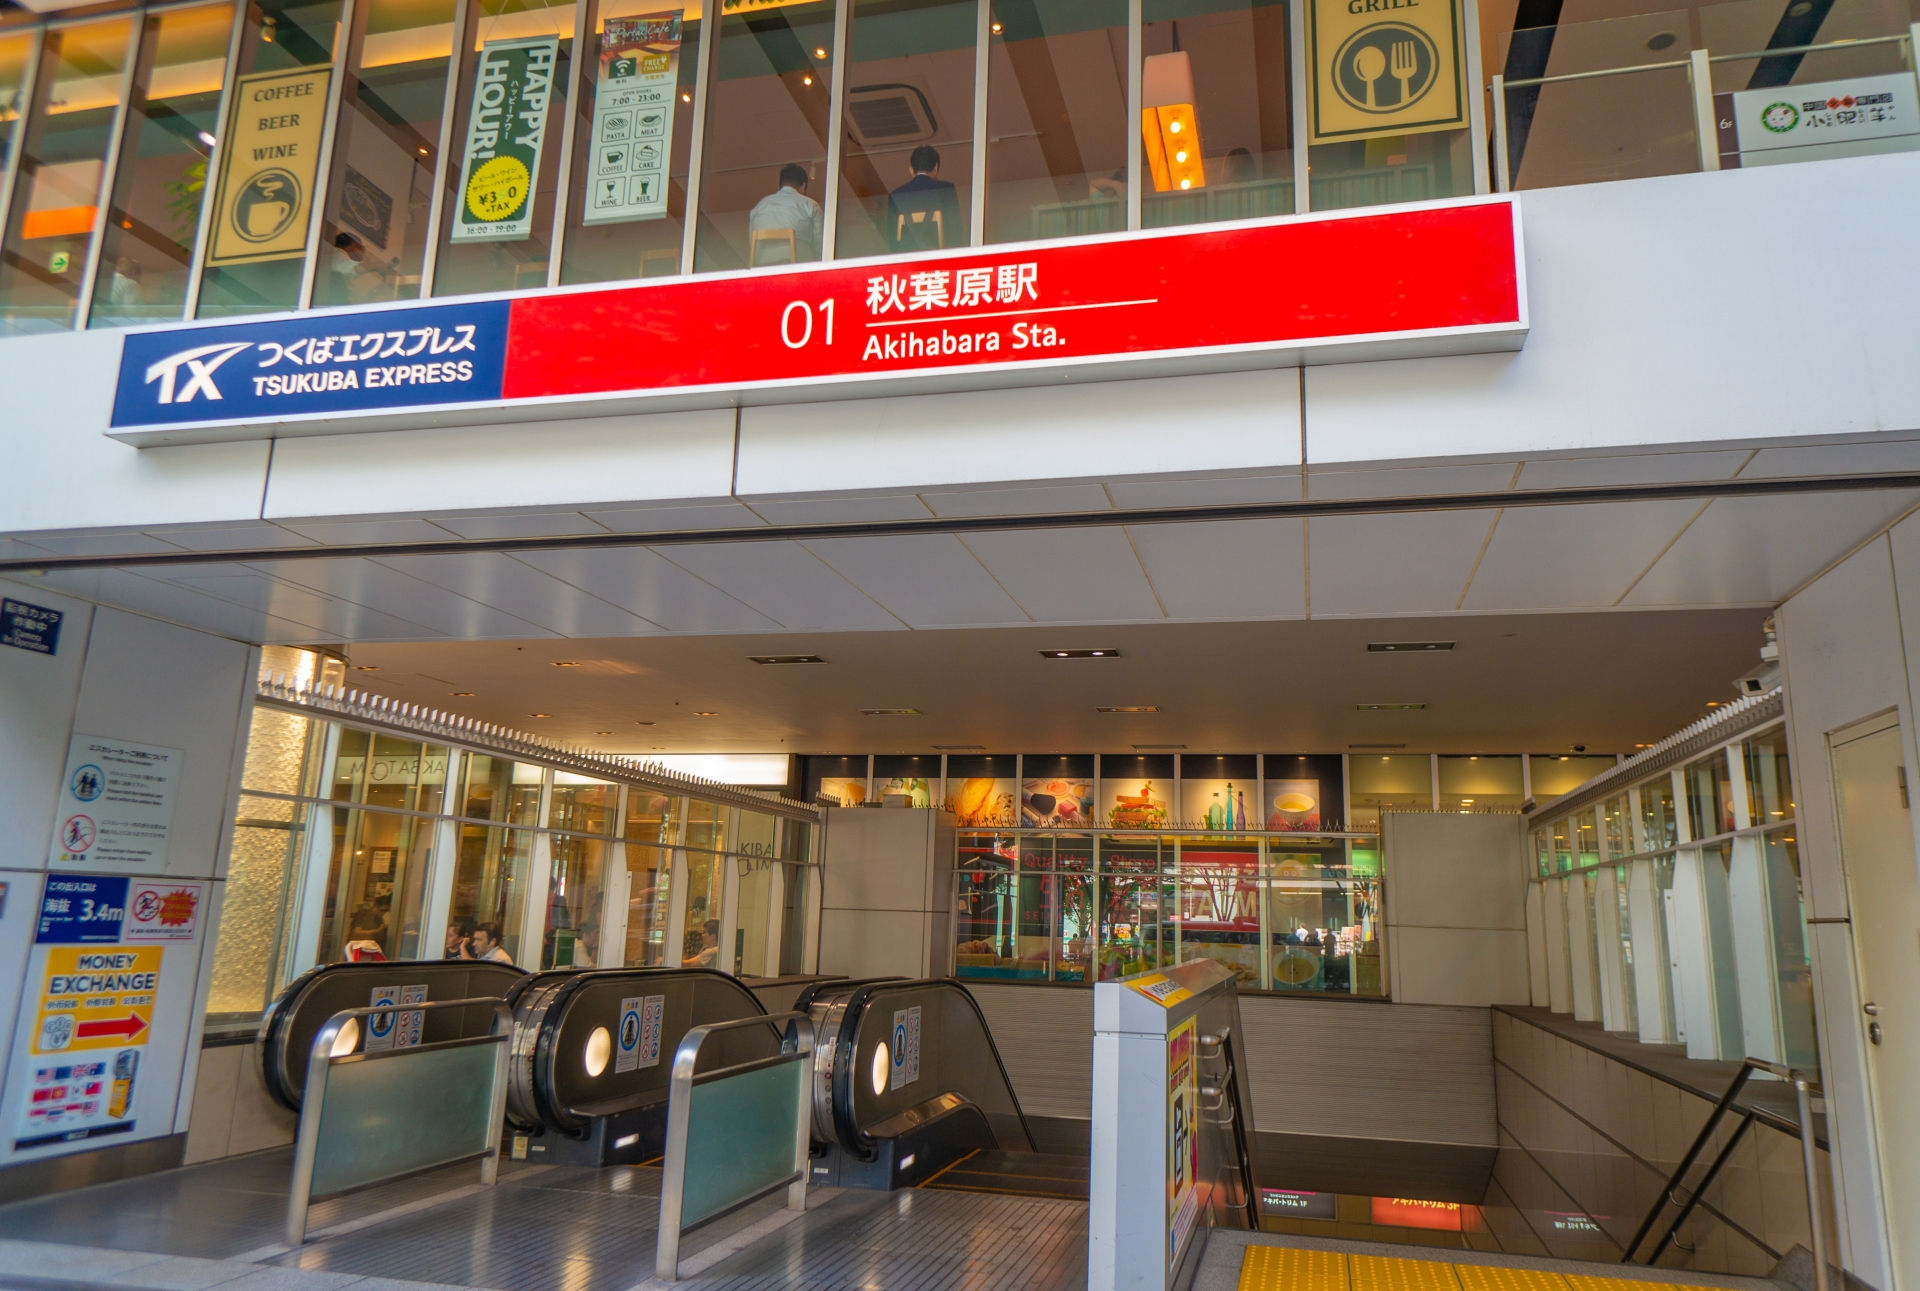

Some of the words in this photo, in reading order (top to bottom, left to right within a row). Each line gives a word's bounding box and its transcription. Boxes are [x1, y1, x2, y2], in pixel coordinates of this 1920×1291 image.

[254, 83, 315, 103] COFFEE
[515, 47, 552, 150] HAPPY
[612, 96, 630, 106] 7:00
[637, 93, 661, 102] 23:00
[471, 60, 510, 160] HOUR!
[503, 79, 519, 140] ハッピーアワー
[257, 113, 301, 131] BEER
[1719, 118, 1733, 129] 6F
[606, 132, 625, 140] PASTA
[640, 128, 658, 136] MEAT
[252, 143, 298, 161] WINE
[601, 165, 623, 173] COFFEE
[466, 226, 488, 235] 16:00
[495, 224, 517, 233] 19:00
[865, 261, 1039, 315] 秋葉原駅
[780, 298, 835, 349] 01
[257, 324, 477, 368] つくばエクスプレス
[862, 328, 1000, 361] Akihabara
[1012, 323, 1067, 350] Sta.
[253, 368, 359, 397] TSUKUBA
[364, 360, 474, 388] EXPRESS
[15, 629, 43, 641] Camera
[1024, 853, 1088, 871] Quality
[1110, 854, 1155, 870] Store
[49, 881, 97, 892] この出入口は
[45, 898, 72, 913] 海抜
[80, 899, 124, 922] 3.4m
[78, 954, 138, 970] MONEY
[49, 973, 157, 994] EXCHANGE
